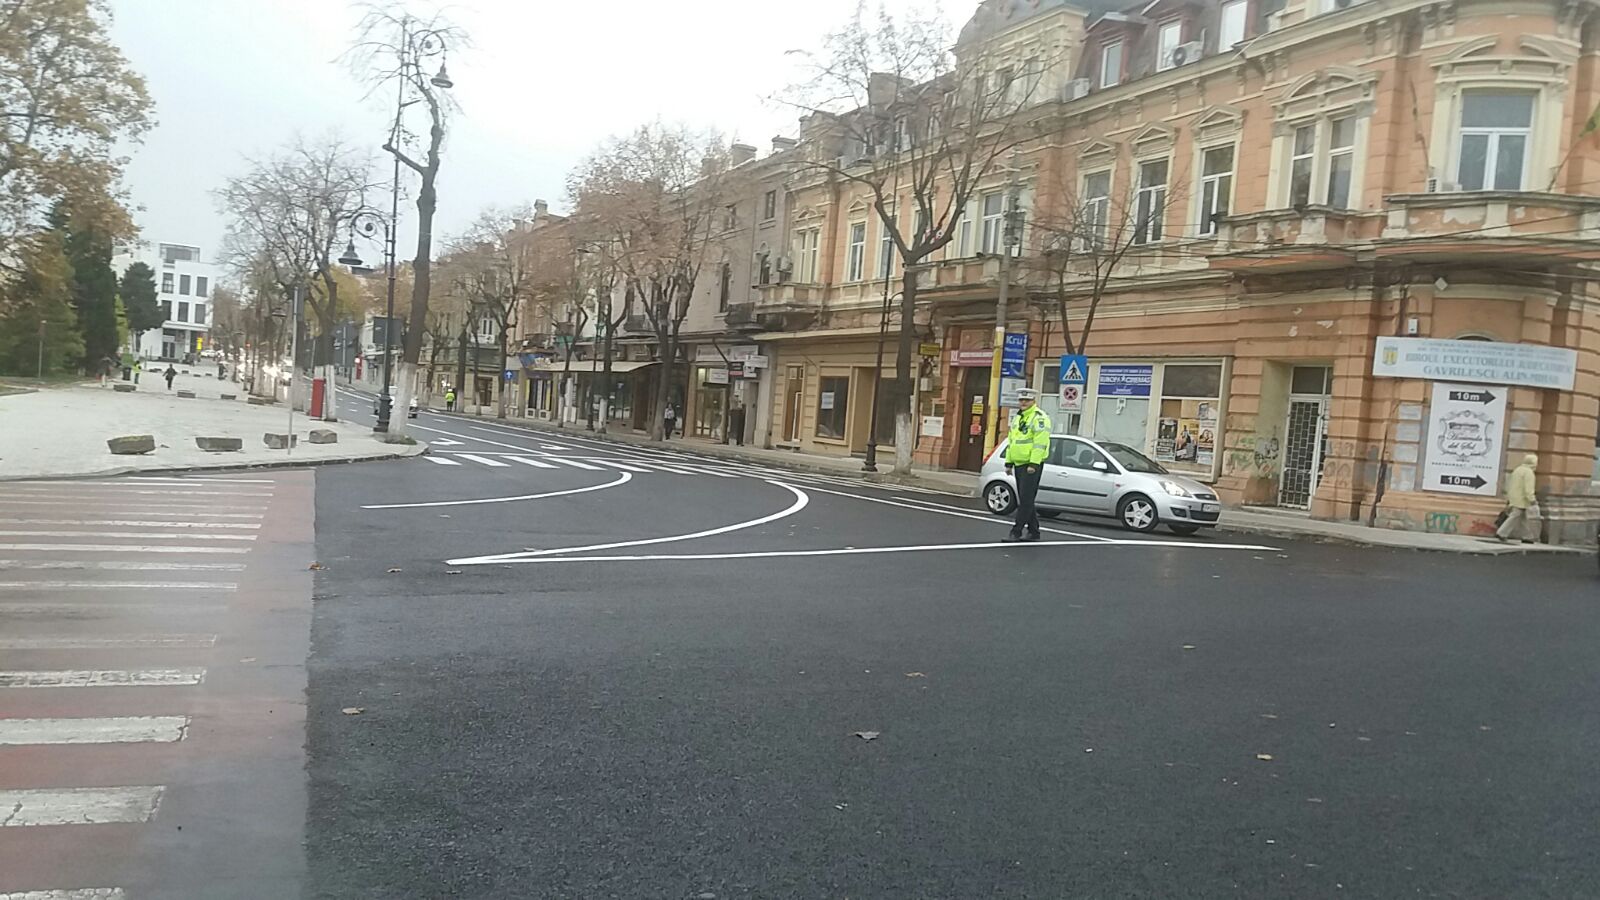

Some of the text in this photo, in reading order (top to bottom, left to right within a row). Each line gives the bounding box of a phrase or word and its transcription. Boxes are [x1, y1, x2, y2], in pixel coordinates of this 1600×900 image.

[1423, 366, 1498, 379] GAVRILESCU
[1456, 392, 1480, 401] 10m
[1447, 476, 1471, 485] 10m
